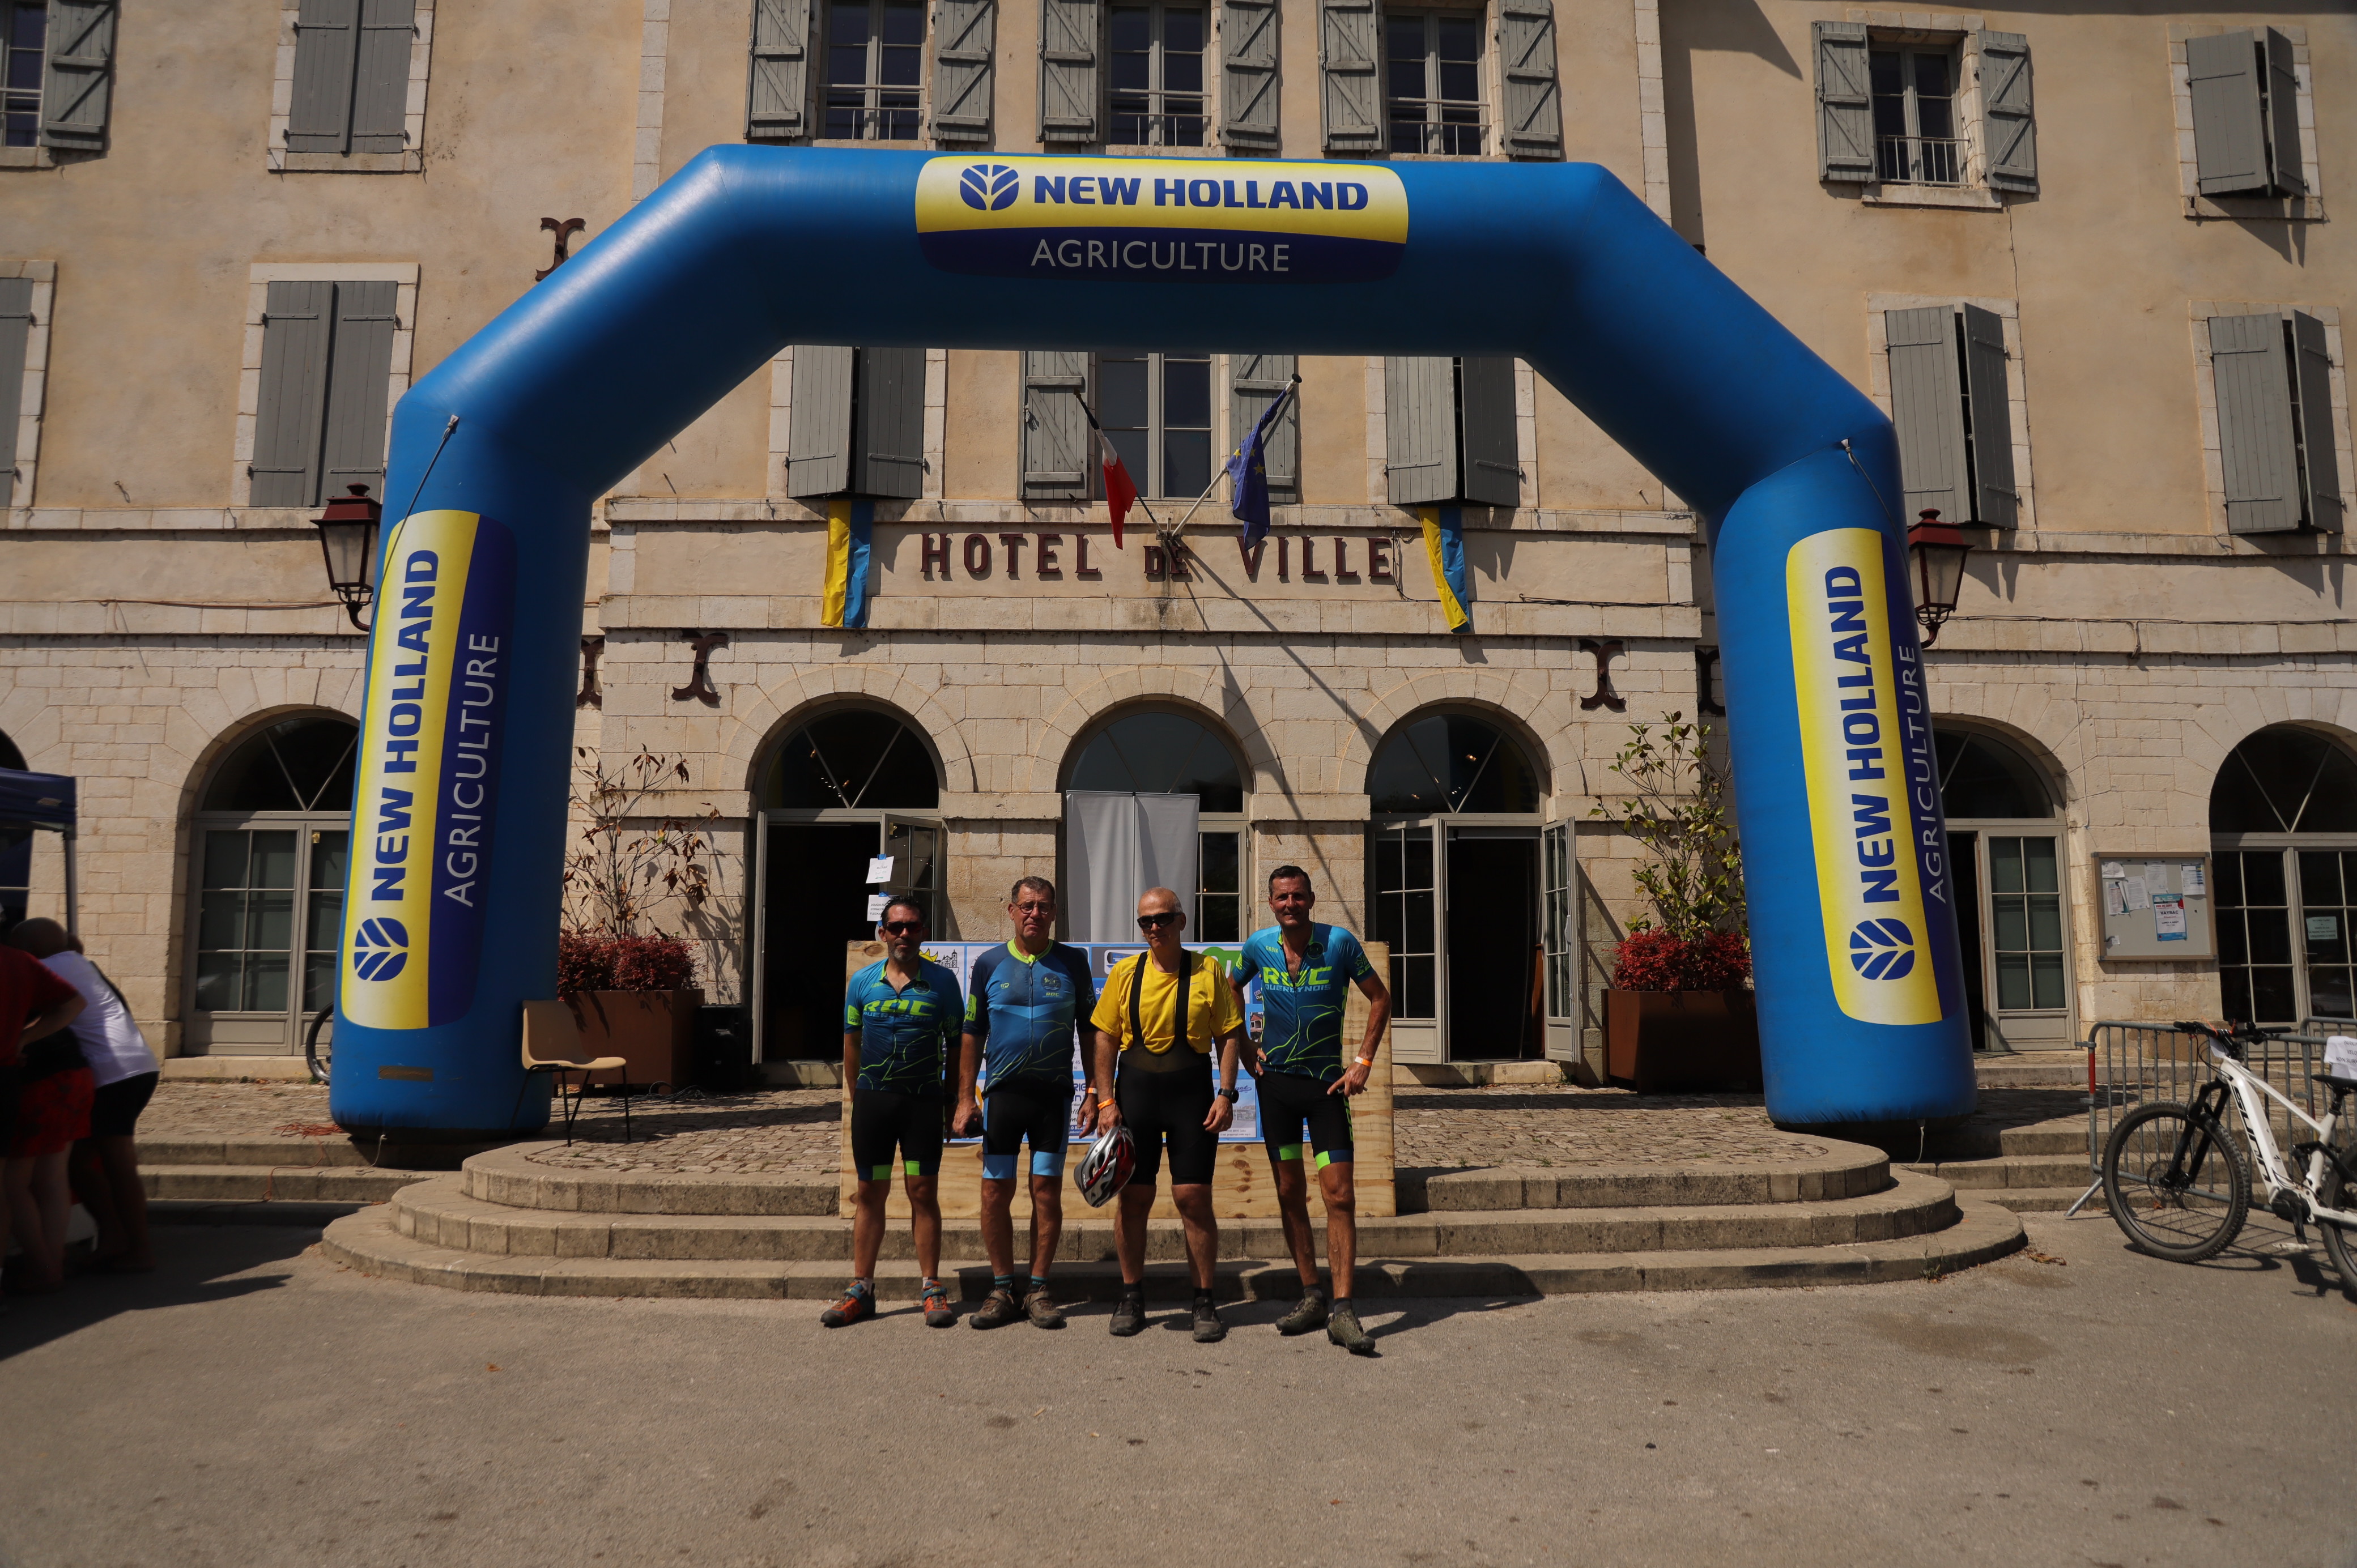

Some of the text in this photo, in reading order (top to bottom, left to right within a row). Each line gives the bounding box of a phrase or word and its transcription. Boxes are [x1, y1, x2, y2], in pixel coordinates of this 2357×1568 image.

[1034, 175, 1369, 211] NEW HOLLAND
[1030, 238, 1290, 272] AGRICULTURE
[920, 533, 1392, 577] HOTEL DE VILLE
[371, 549, 439, 901] NEW HOLLAND
[1824, 566, 1900, 904] NEW HOLLAND
[444, 633, 499, 908] AGRICULTURE
[1898, 645, 1947, 904] AGRICULTURE
[1262, 966, 1333, 988] ROC
[863, 998, 937, 1017] ROC
